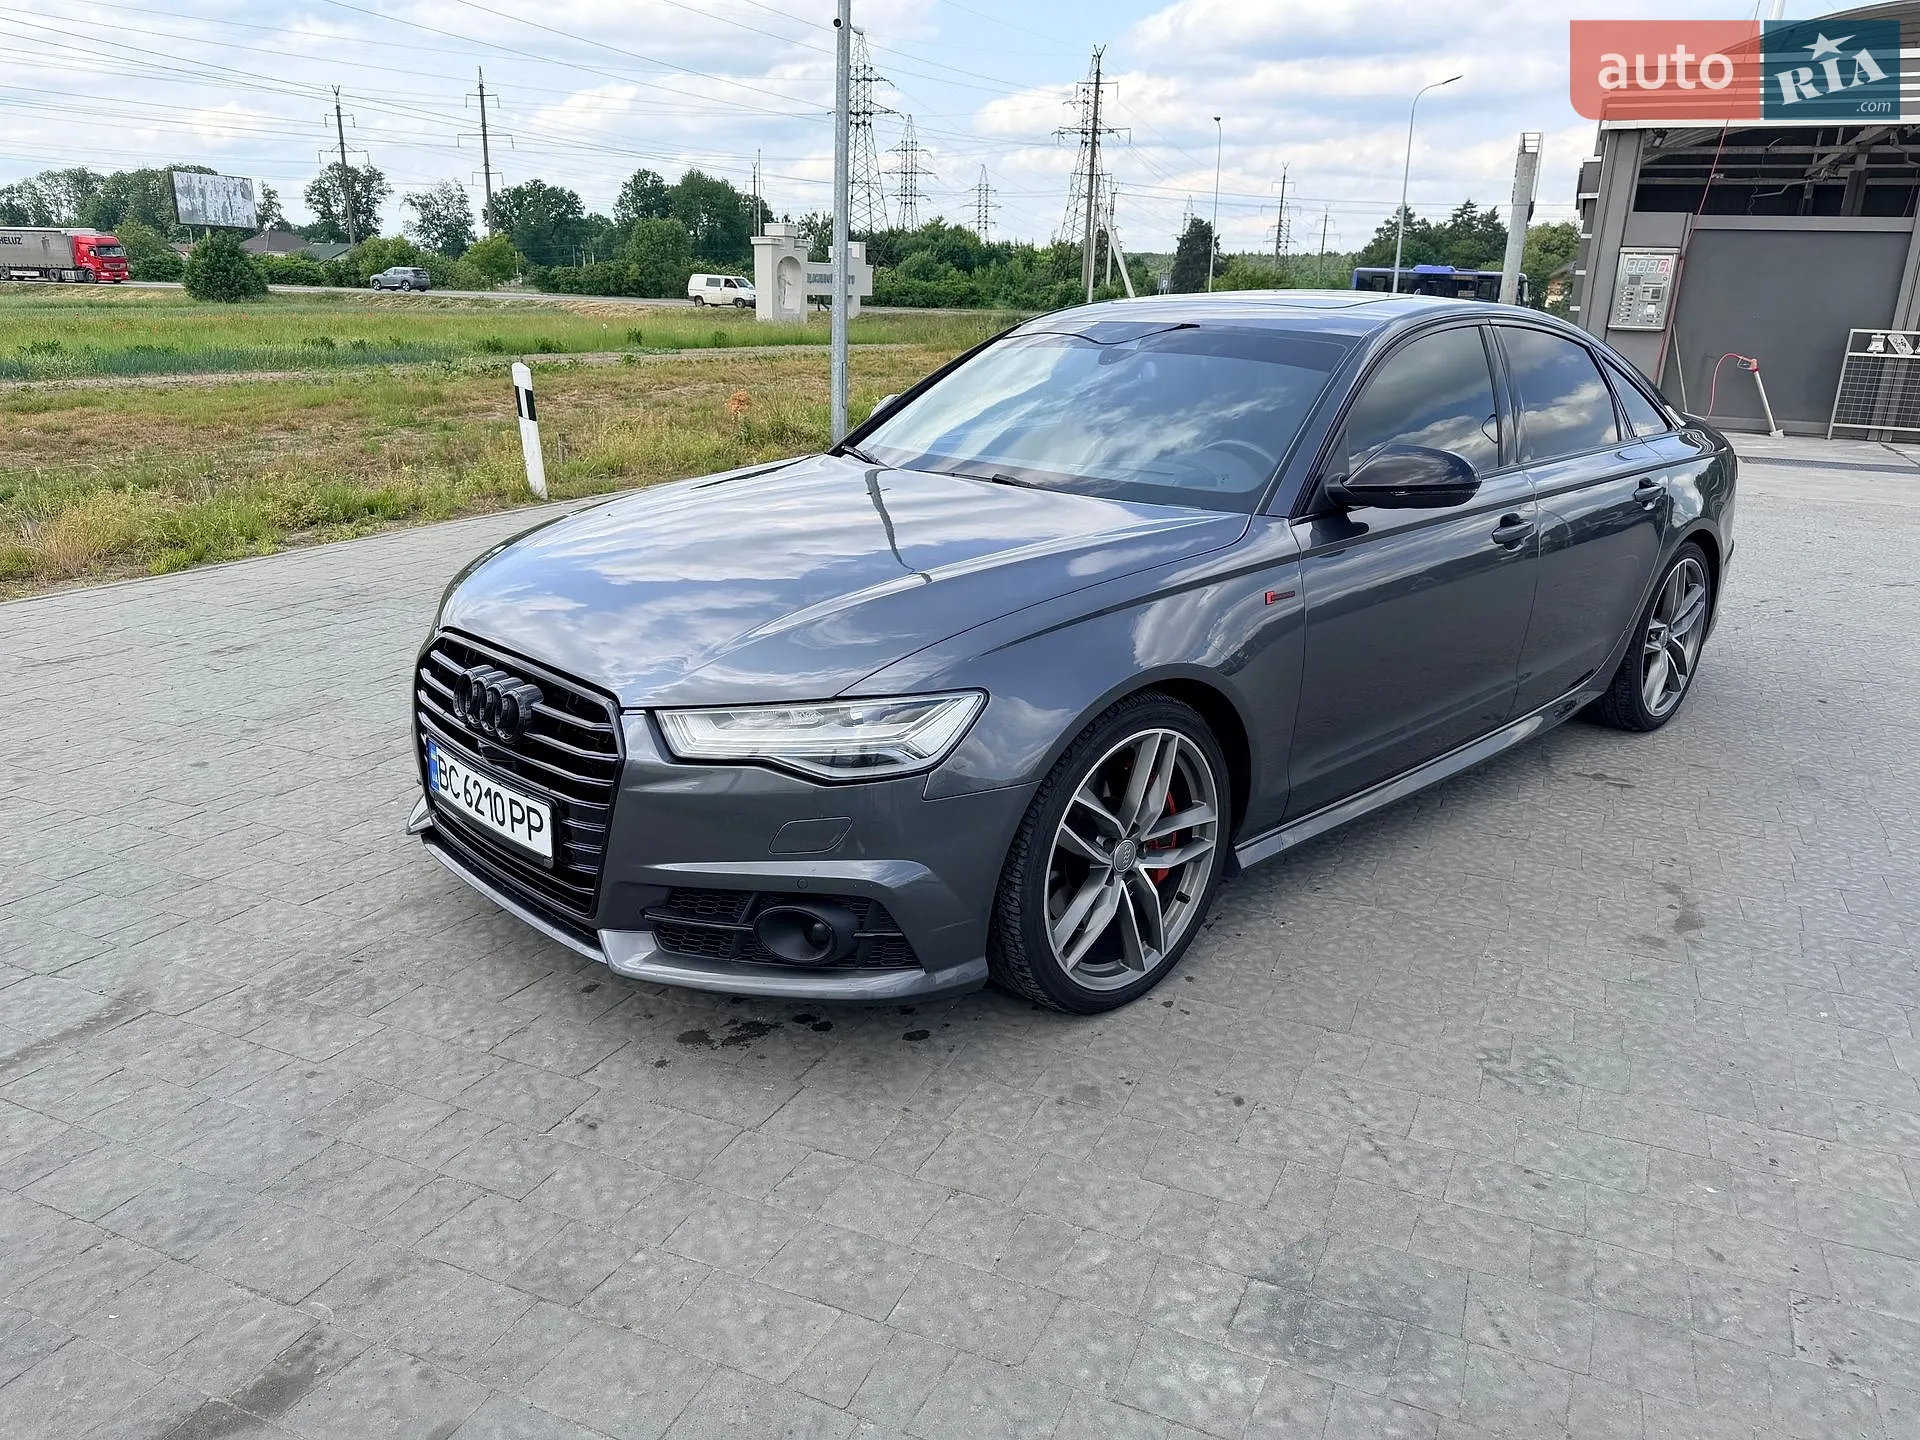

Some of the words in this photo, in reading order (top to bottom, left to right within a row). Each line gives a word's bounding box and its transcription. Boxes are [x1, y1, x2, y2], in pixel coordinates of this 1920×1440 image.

[437, 754, 460, 799] BC
[463, 774, 506, 827] 6210
[508, 797, 544, 841] PP
